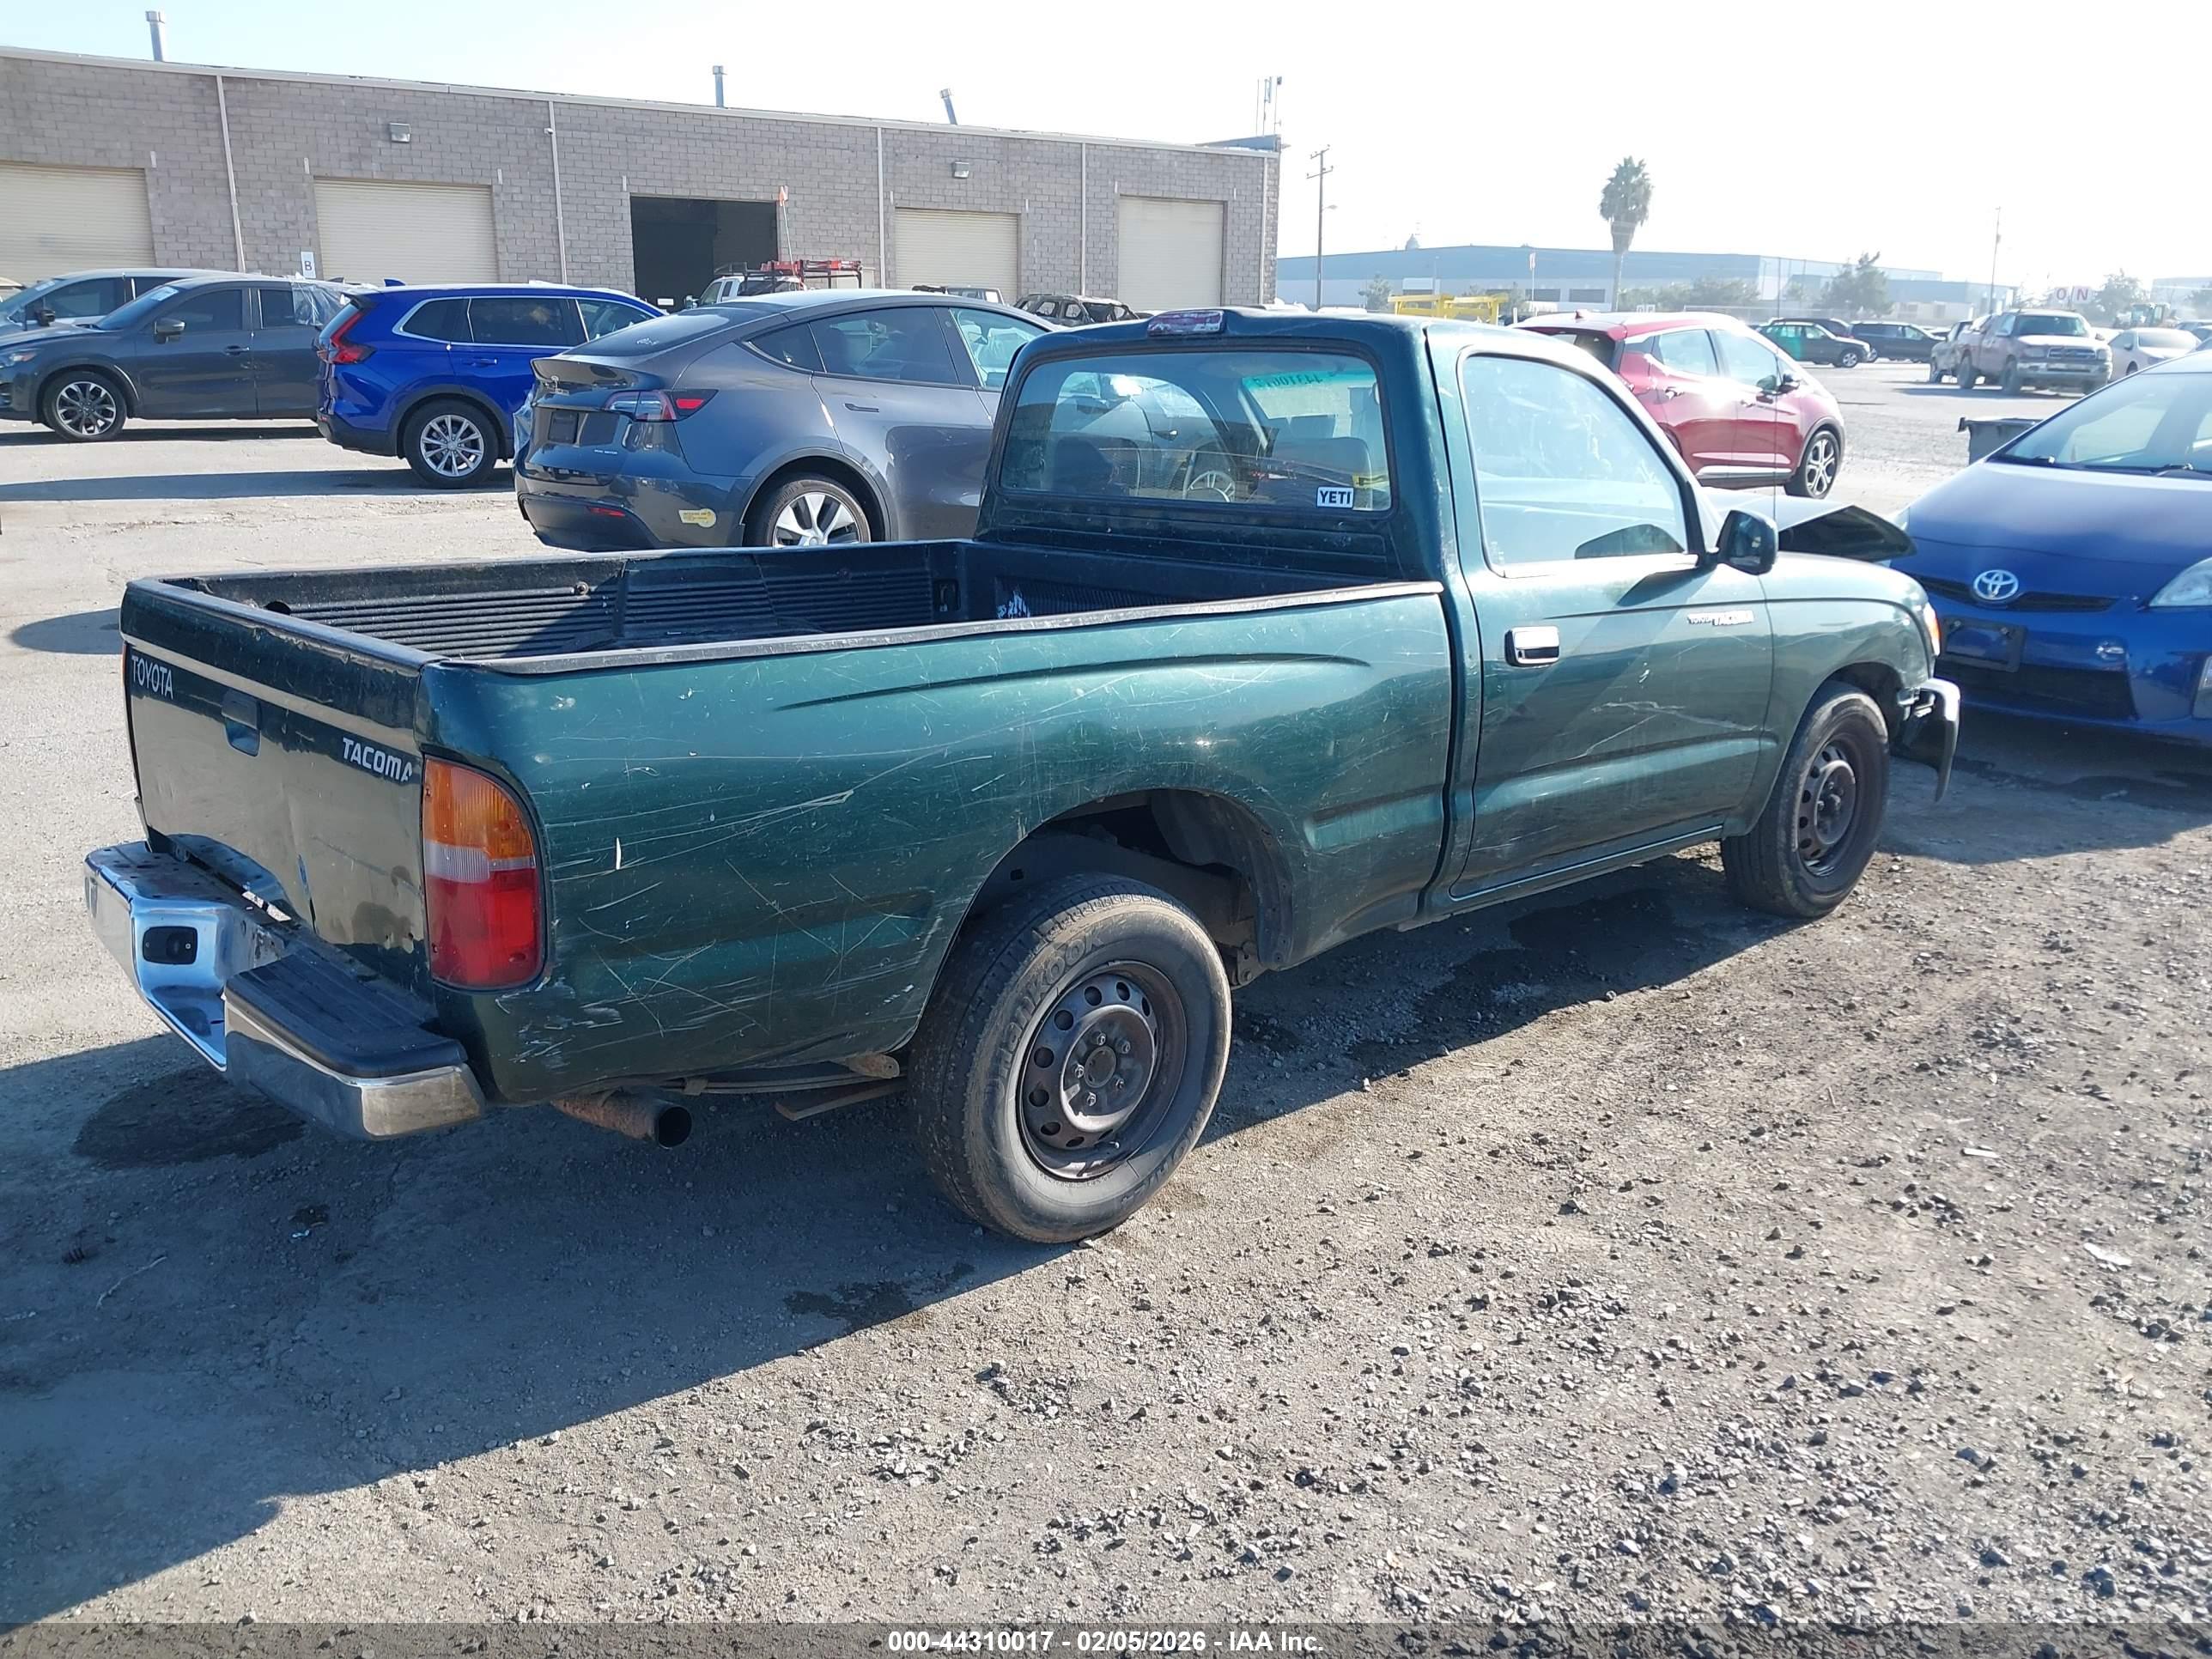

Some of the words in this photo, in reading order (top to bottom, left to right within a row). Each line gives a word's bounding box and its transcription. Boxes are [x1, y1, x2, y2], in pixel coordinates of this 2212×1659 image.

[305, 260, 313, 270] B
[1320, 490, 1352, 504] YETI
[131, 655, 173, 700] TOYOTA
[343, 737, 413, 782] TACOMA
